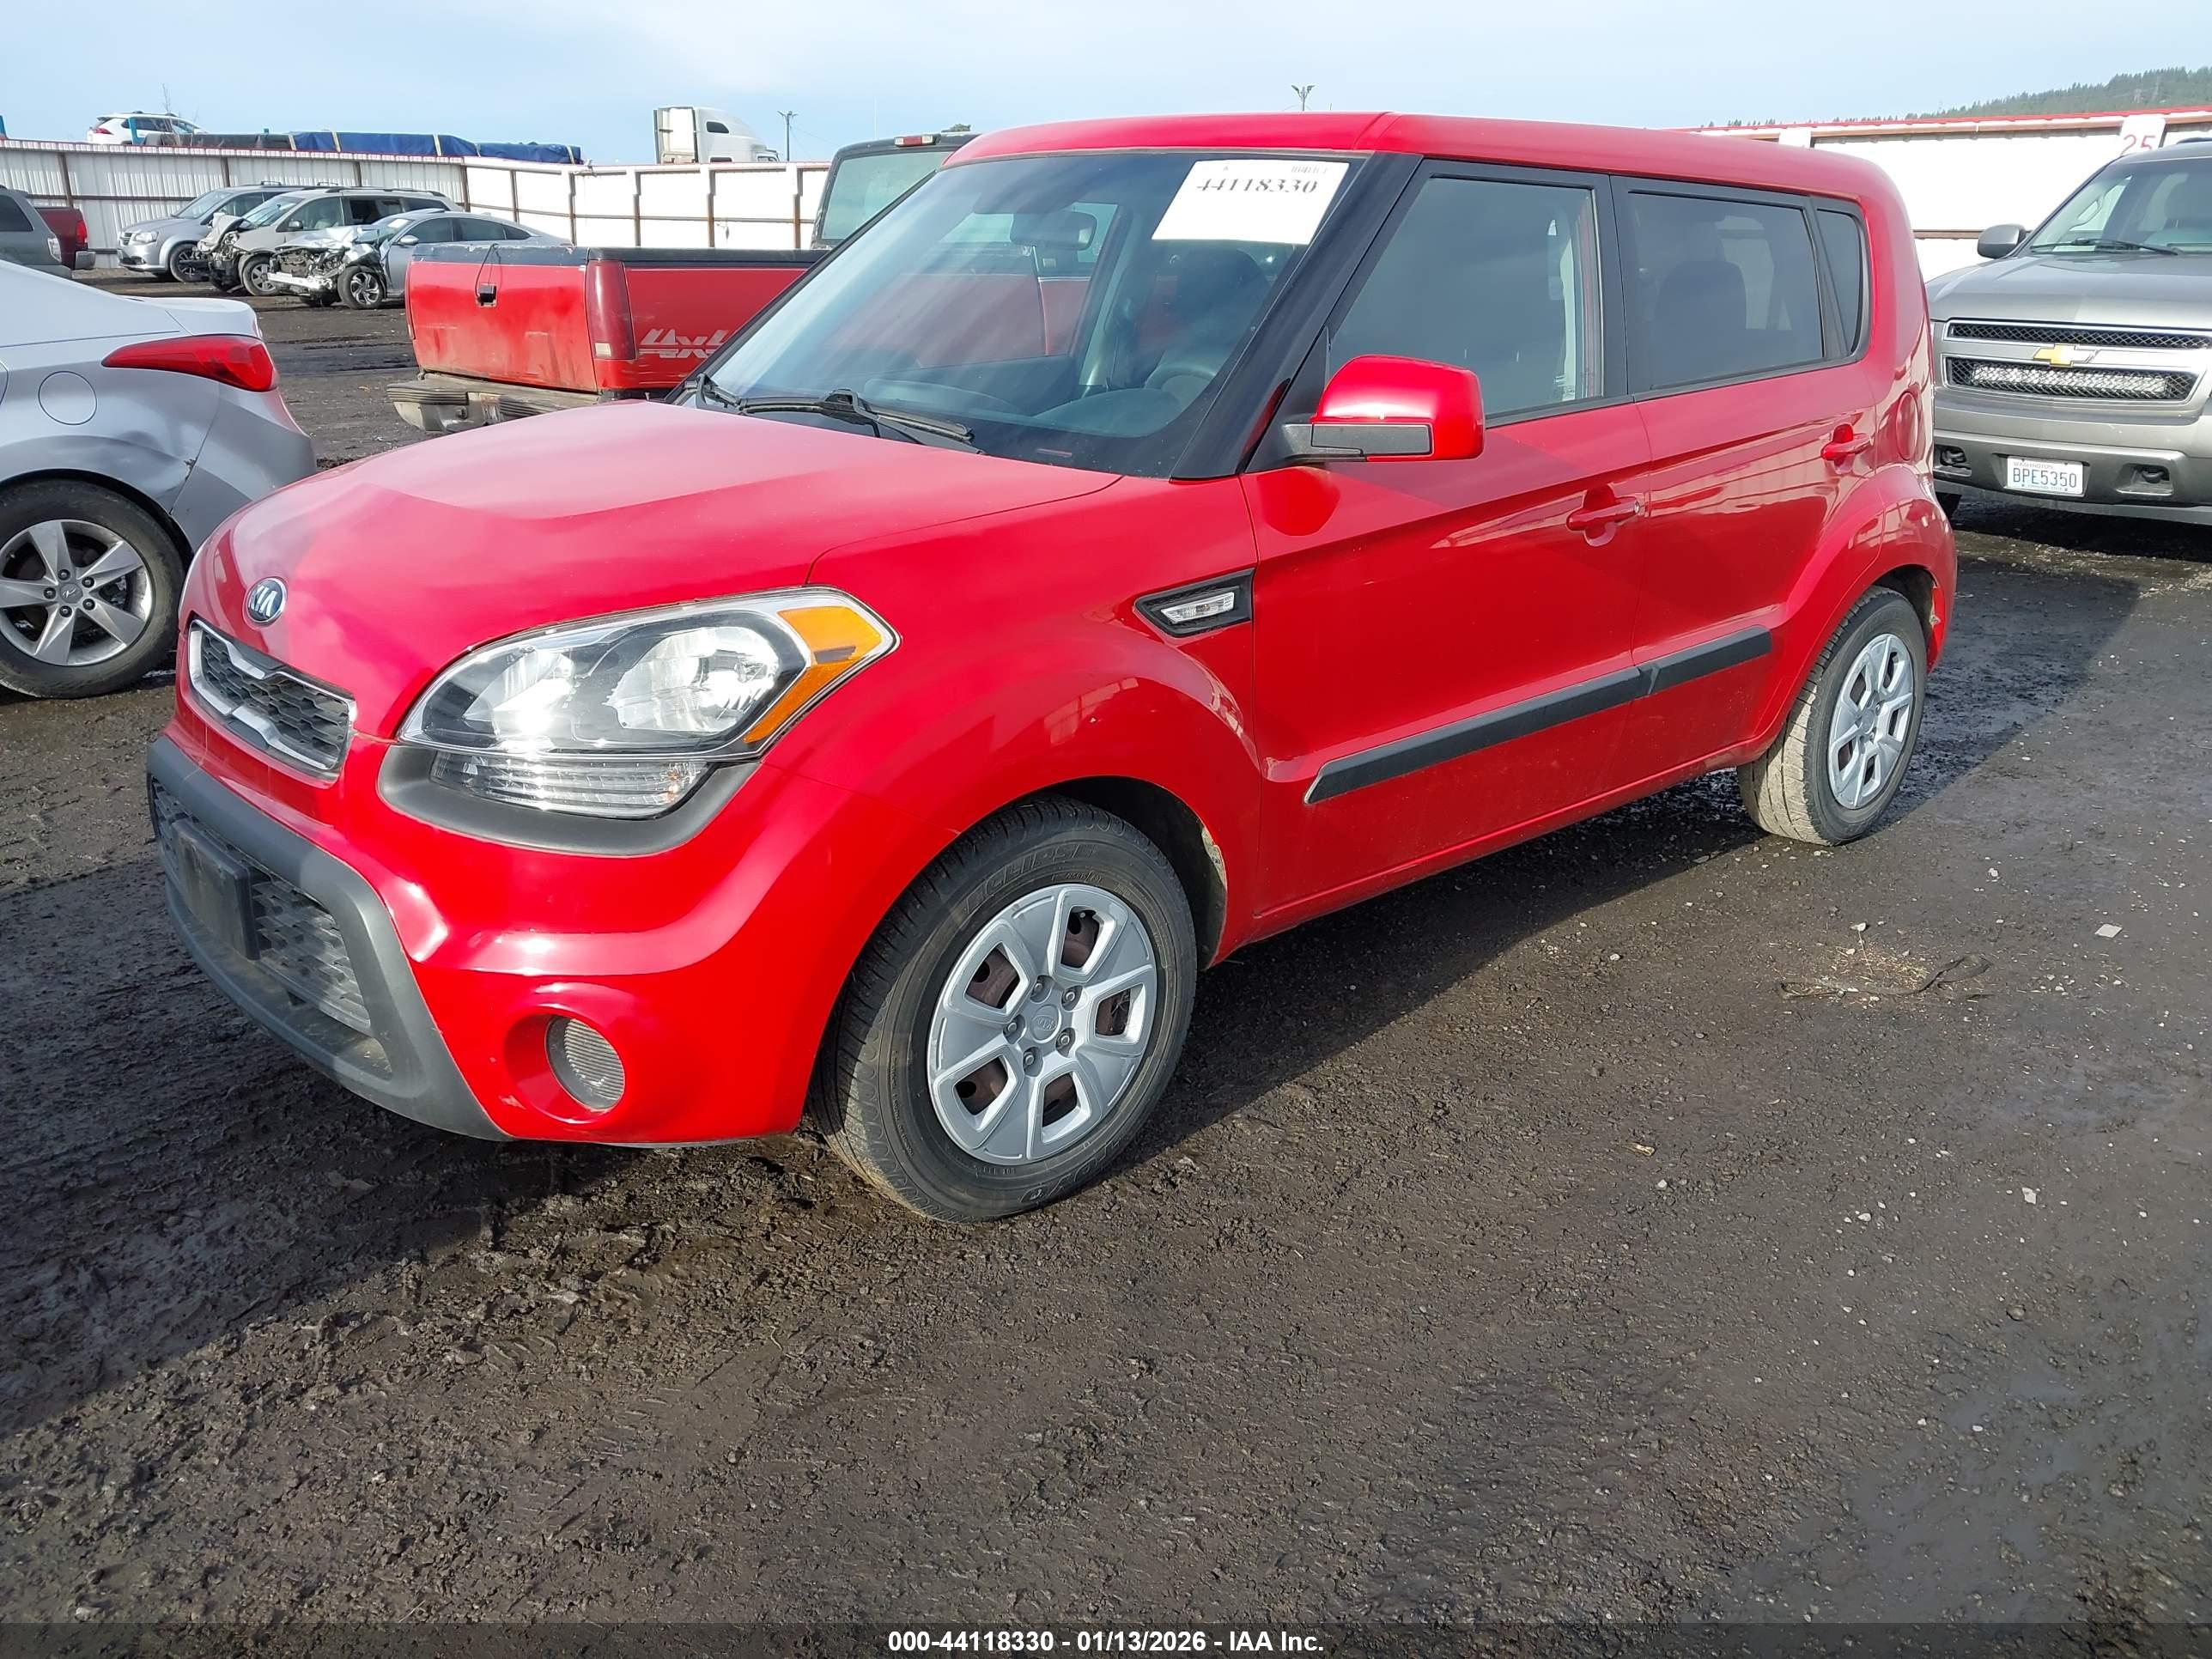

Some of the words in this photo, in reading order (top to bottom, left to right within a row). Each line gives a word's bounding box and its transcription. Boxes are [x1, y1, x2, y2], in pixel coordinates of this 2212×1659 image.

[2119, 134, 2156, 155] 25
[1196, 178, 1318, 193] 44118330
[2013, 467, 2077, 488] BPE5350
[250, 585, 277, 617] KIA
